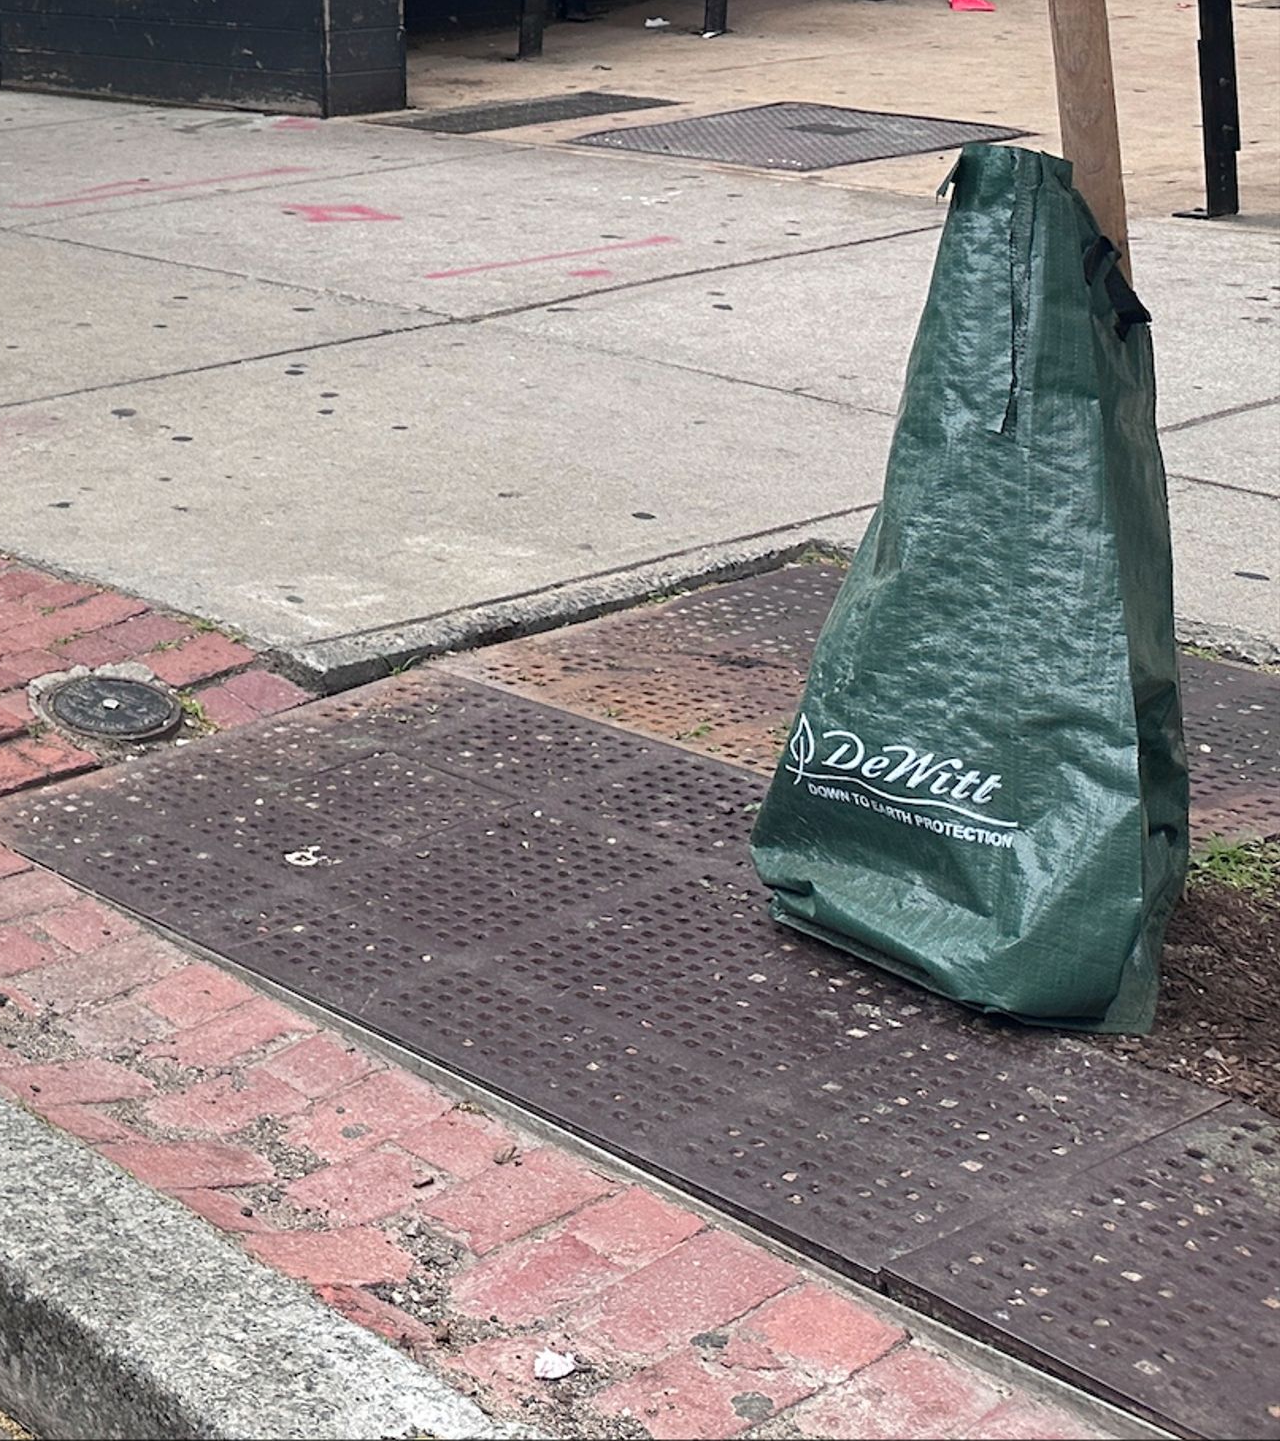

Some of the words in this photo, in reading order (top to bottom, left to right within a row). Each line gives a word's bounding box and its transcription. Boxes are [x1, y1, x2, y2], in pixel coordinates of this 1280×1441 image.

[821, 730, 1003, 805] DeWitt
[808, 781, 852, 803] DOWN
[851, 792, 870, 809] TO
[871, 800, 913, 825] EARTH
[914, 814, 1015, 849] PROTECTION
